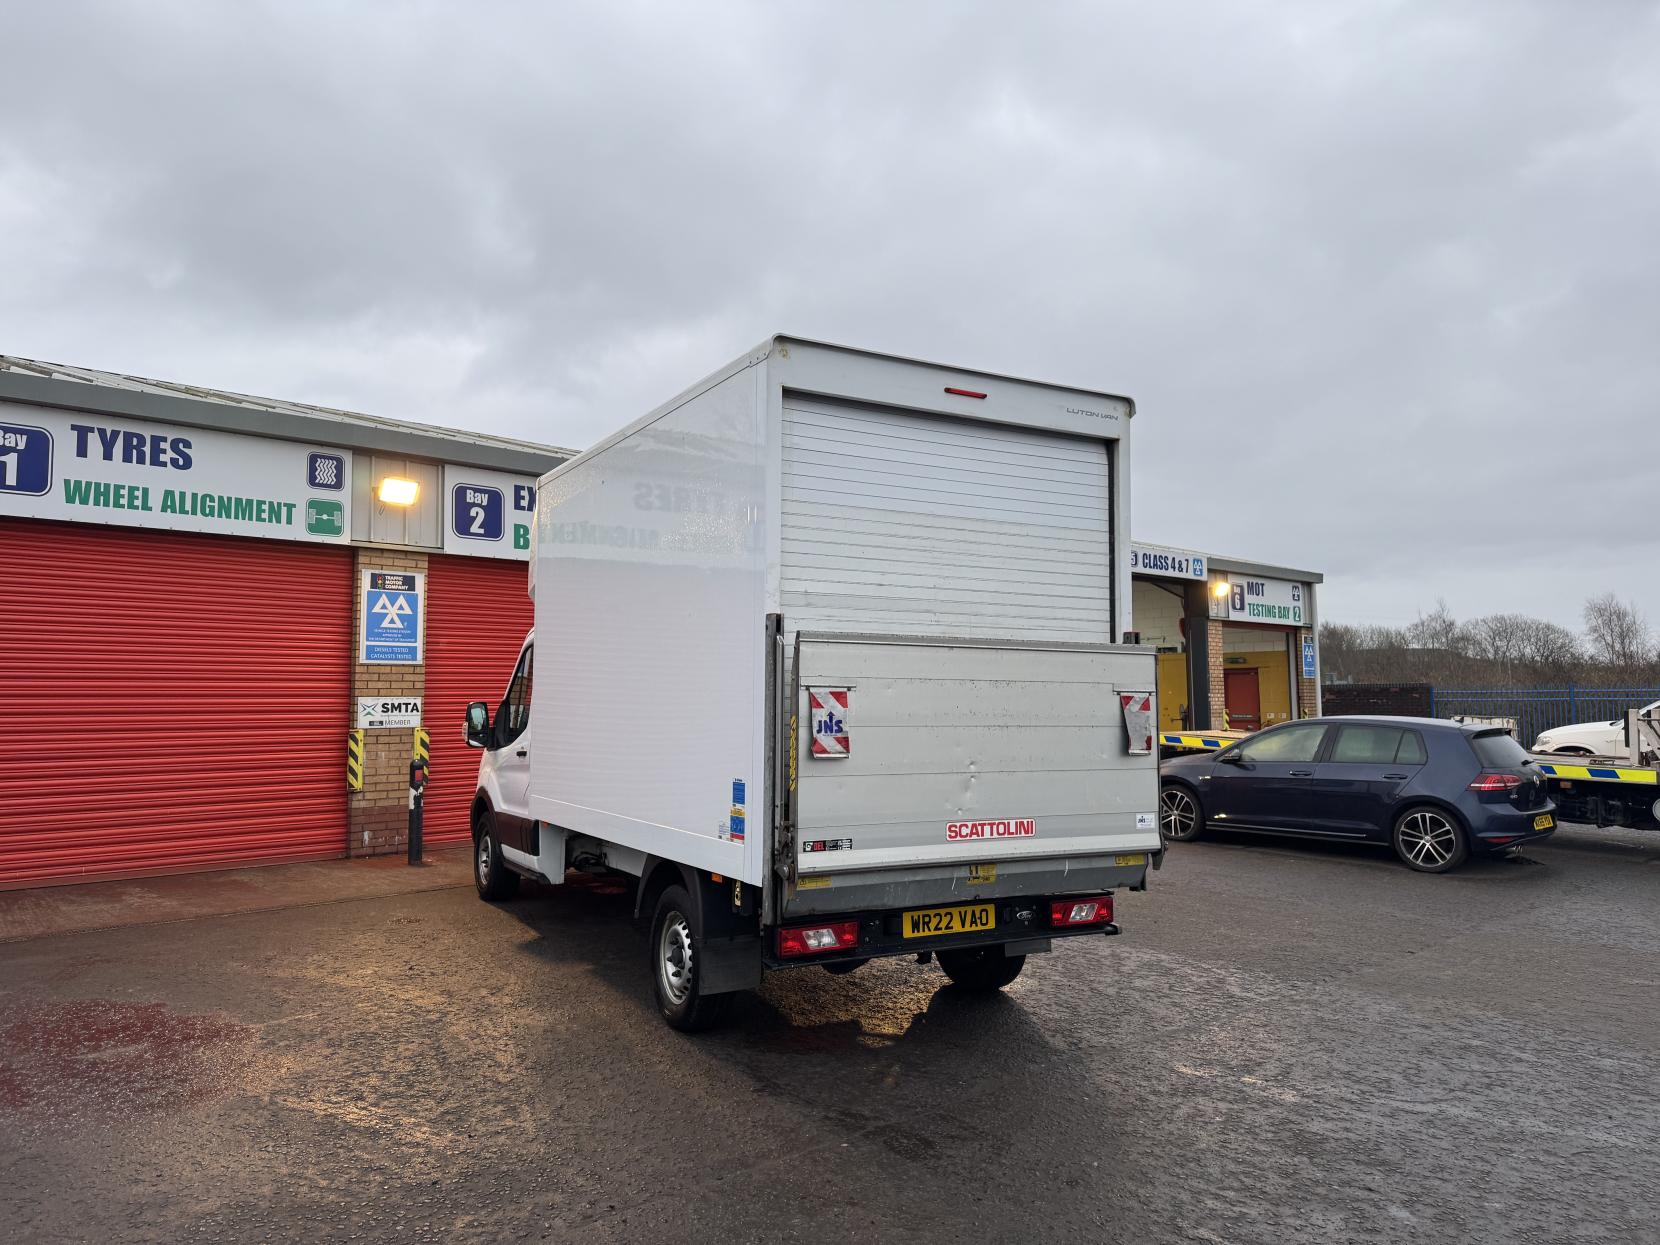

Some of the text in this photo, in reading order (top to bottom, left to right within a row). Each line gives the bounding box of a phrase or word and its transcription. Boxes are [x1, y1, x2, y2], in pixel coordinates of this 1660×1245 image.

[1066, 407, 1099, 417] LUTON
[70, 424, 193, 471] TYRES
[0, 452, 18, 486] 1
[63, 478, 297, 525] WHEEL ALIGNMENT
[466, 489, 489, 506] Bay
[469, 506, 485, 534] 2
[1142, 552, 1169, 571] CLASS
[1170, 556, 1176, 572] 4
[1177, 559, 1184, 573] &
[1184, 558, 1189, 573] 7
[1246, 581, 1265, 597] MOT
[1234, 593, 1241, 610] 6
[1247, 602, 1290, 620] TESTING BAY
[1294, 606, 1300, 621] 2
[381, 702, 420, 713] SMTA
[816, 719, 844, 735] JNS
[947, 820, 1034, 839] SCATTOLINI
[910, 908, 989, 934] WR22 VAO
